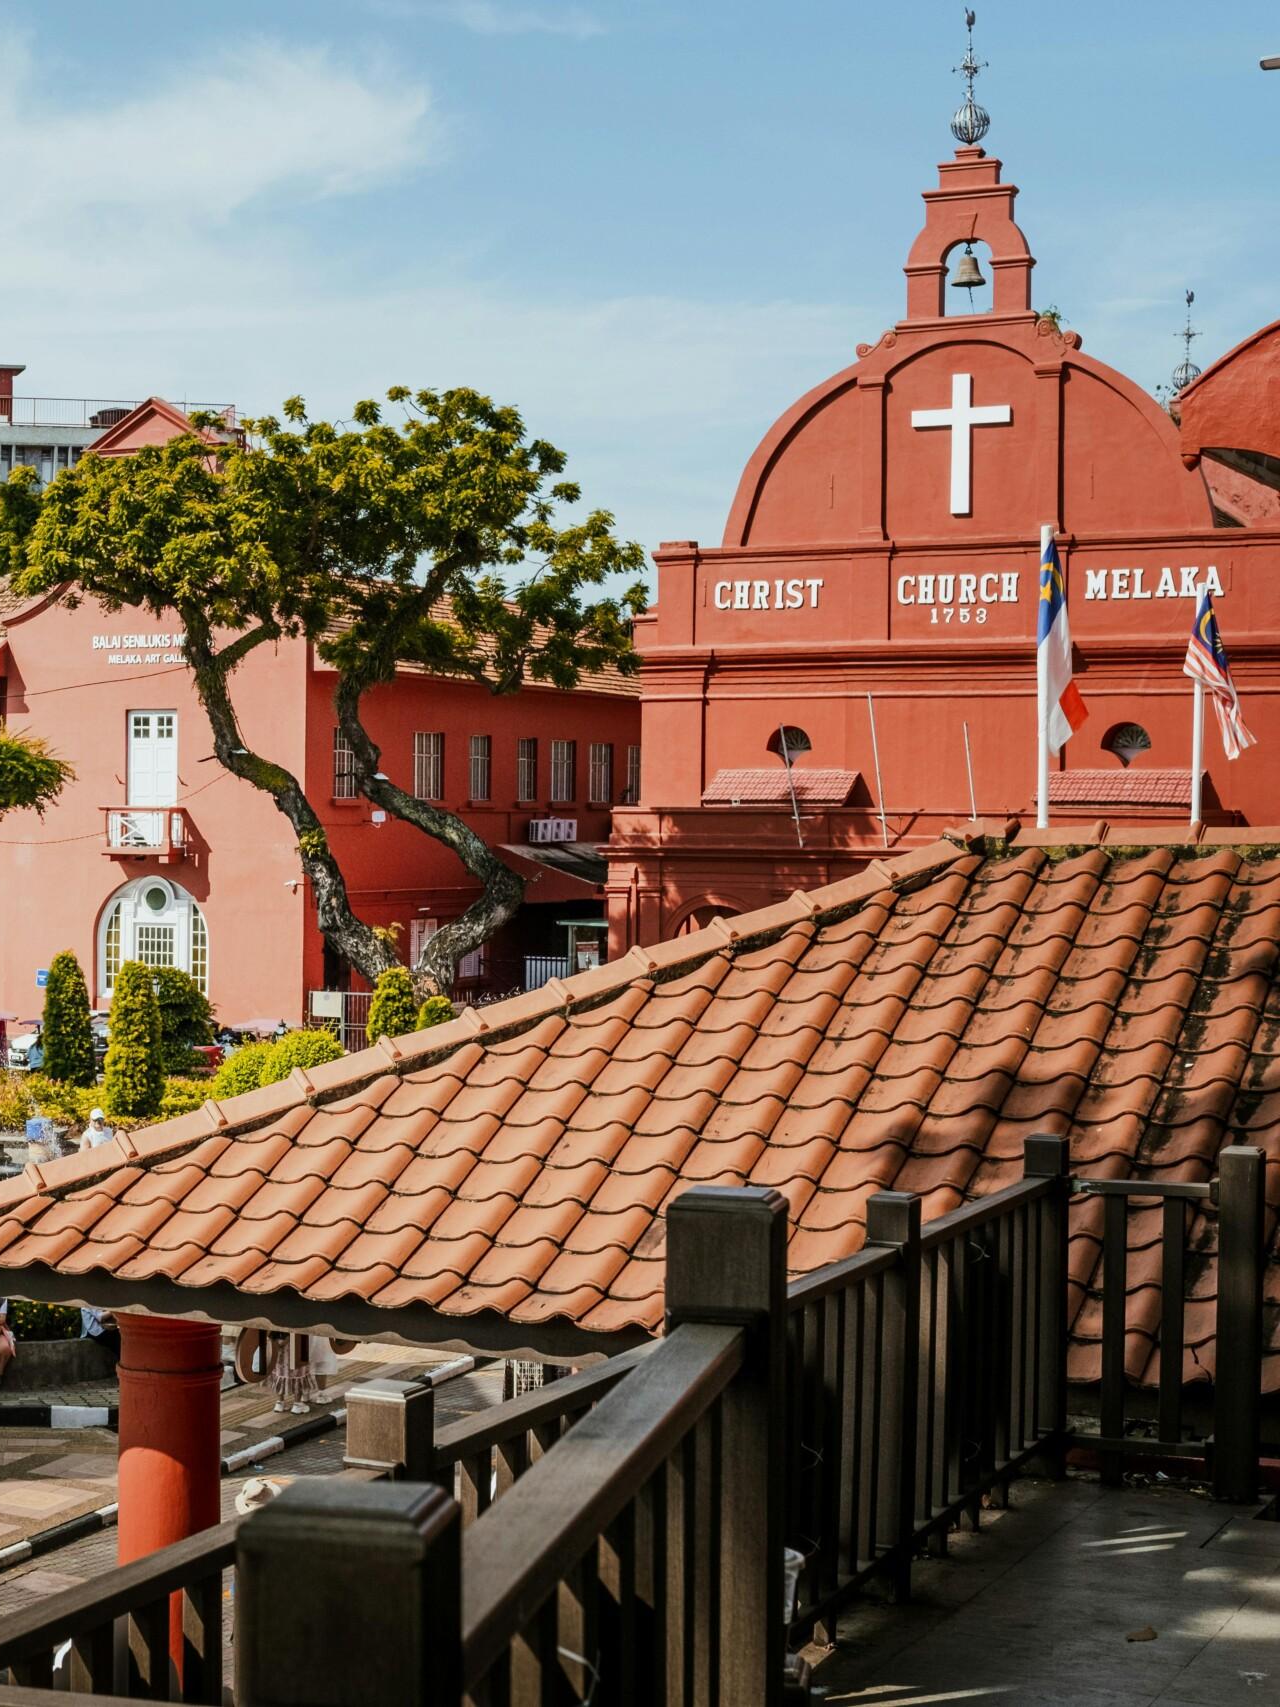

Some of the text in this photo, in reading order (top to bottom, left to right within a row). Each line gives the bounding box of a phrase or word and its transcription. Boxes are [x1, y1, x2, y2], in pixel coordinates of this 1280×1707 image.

[714, 566, 1225, 610] CHRIST CHURCH MELAKA
[930, 608, 987, 624] 1753
[92, 635, 121, 649] BALAI
[108, 654, 142, 665] MELAKA
[144, 654, 162, 664] ART
